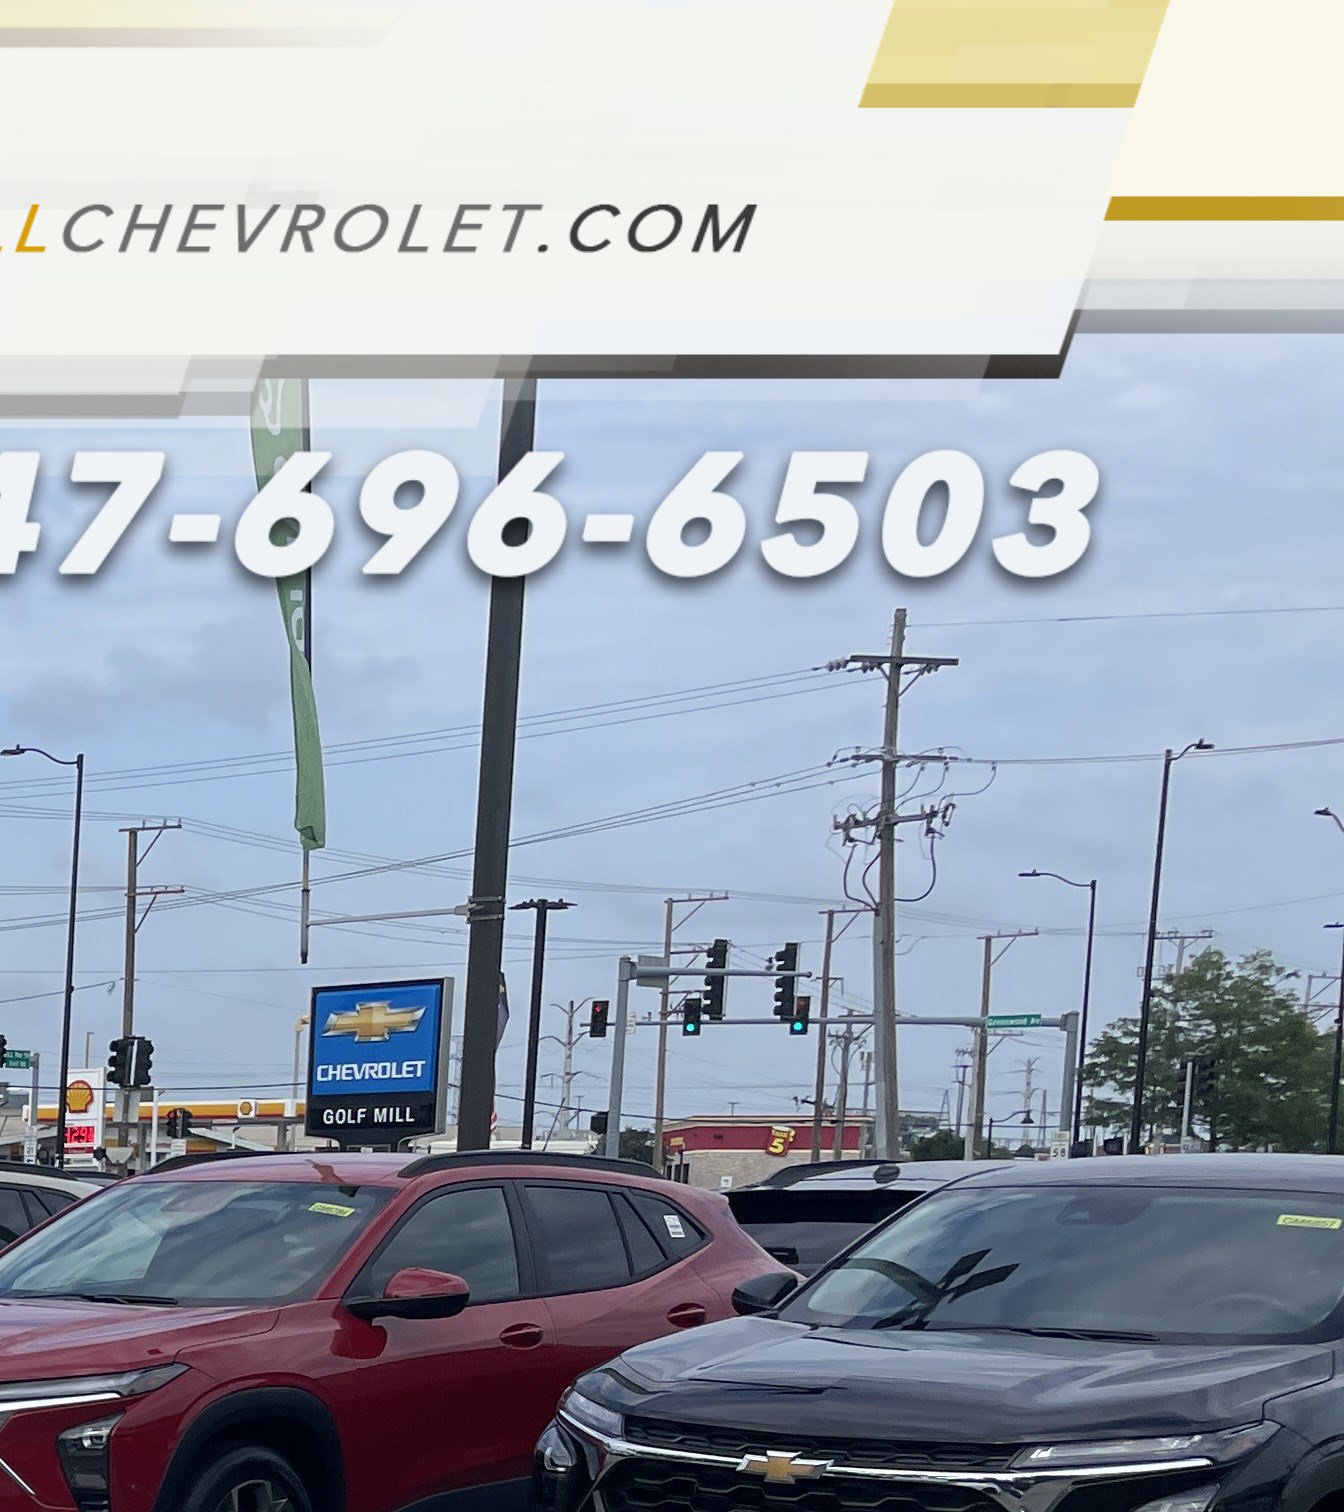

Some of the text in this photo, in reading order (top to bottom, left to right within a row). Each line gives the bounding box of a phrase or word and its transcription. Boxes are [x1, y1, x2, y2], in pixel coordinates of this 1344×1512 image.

[317, 1061, 426, 1081] CHEVROLET
[323, 1107, 415, 1124] GOLF MILL
[769, 1138, 784, 1154] 5
